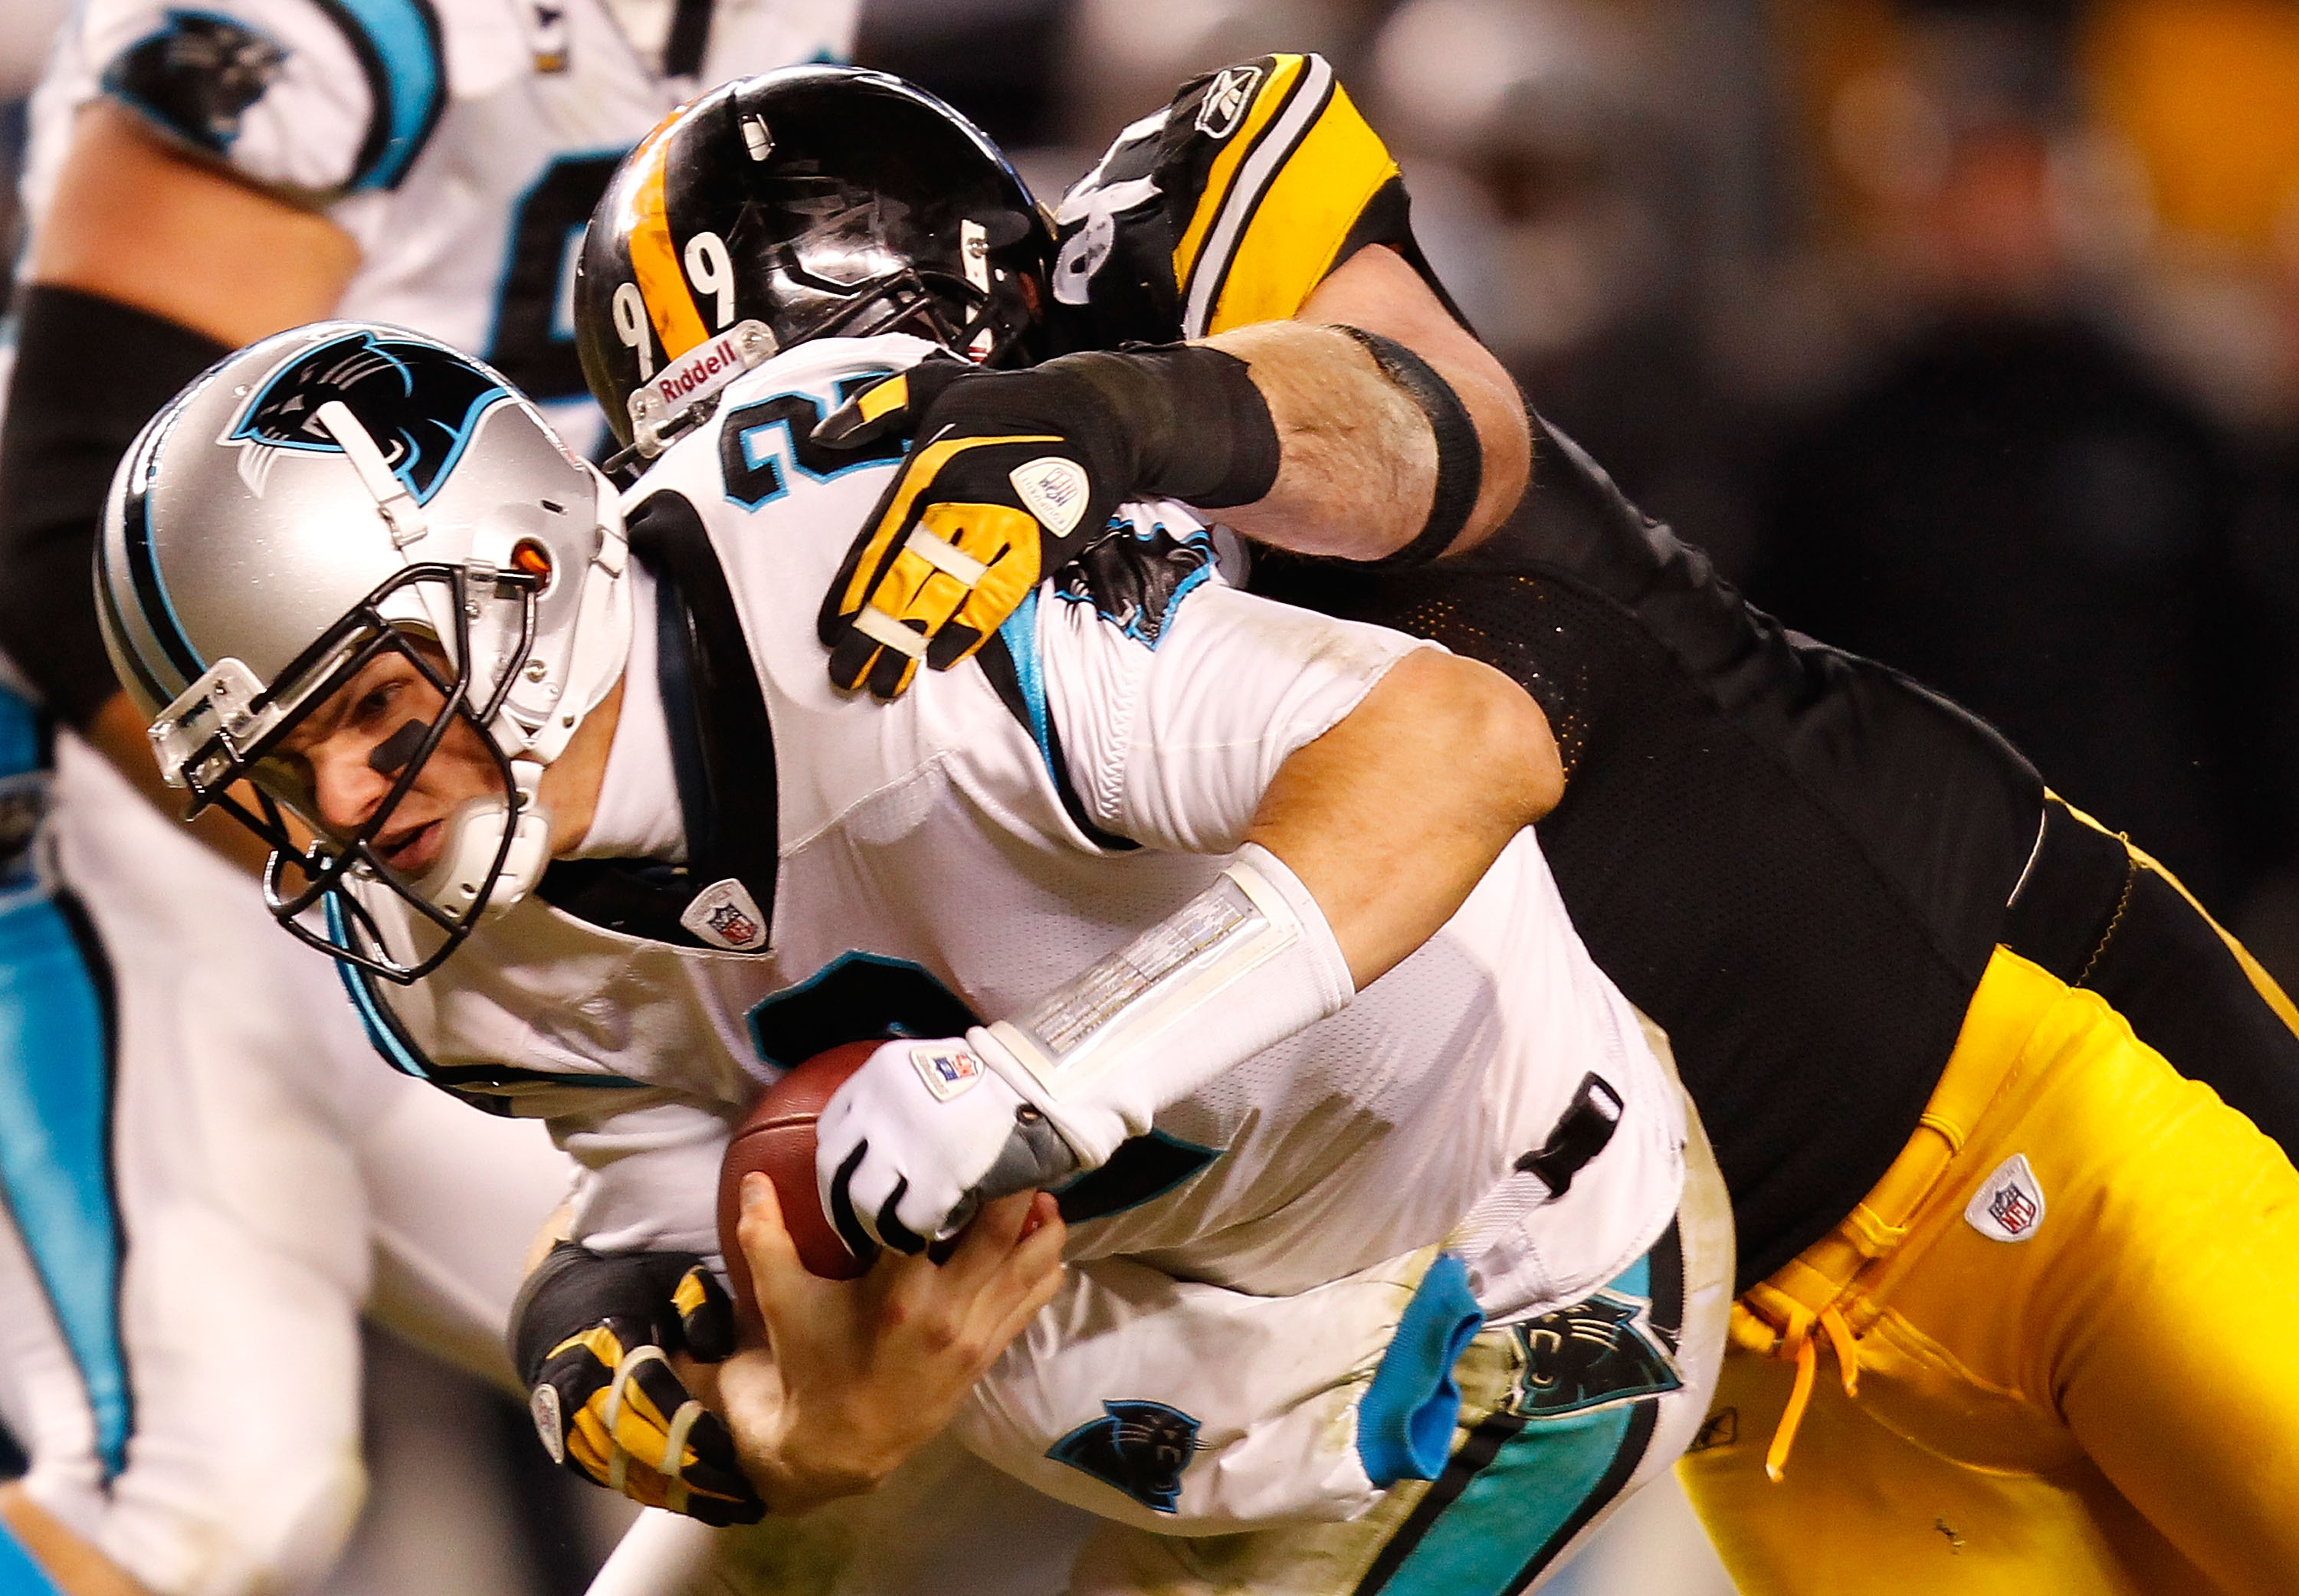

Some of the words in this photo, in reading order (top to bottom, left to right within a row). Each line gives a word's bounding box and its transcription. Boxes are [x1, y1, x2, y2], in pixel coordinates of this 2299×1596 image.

[612, 282, 654, 382] 9
[684, 231, 735, 329] 9
[660, 339, 737, 403] Riddell
[2000, 1199, 2034, 1231] NFL
